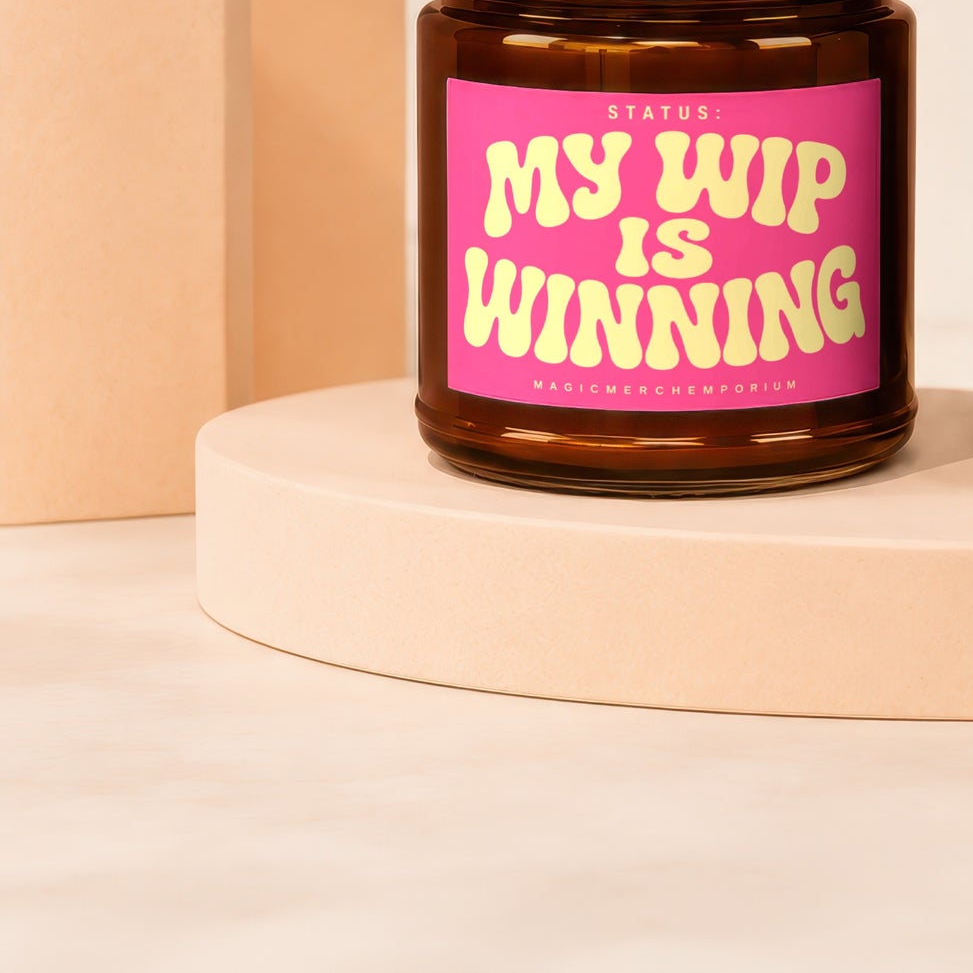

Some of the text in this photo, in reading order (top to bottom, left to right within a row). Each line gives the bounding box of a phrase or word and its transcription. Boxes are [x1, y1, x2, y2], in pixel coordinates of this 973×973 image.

[608, 104, 722, 120] STATUS:
[484, 131, 847, 238] MY WIP
[615, 217, 713, 279] IS
[464, 245, 866, 371] WINNING
[533, 379, 797, 395] MAGICMERCHEMPORIUM
